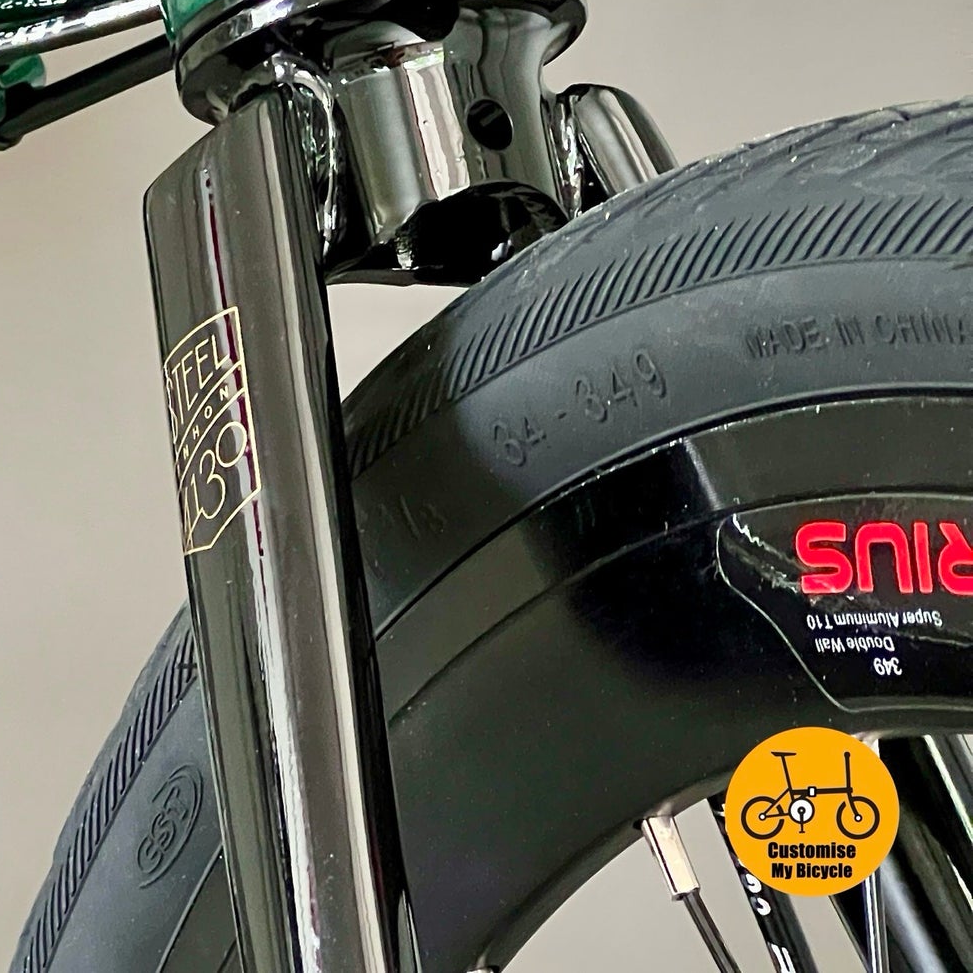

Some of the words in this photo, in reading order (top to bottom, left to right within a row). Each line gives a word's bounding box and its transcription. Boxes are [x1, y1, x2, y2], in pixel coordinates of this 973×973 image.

[745, 315, 824, 359] MADE
[831, 312, 866, 347] IN
[166, 334, 231, 444] STEEL
[176, 384, 229, 477] NHON
[806, 613, 834, 630] T10
[833, 611, 900, 628] Aluminum
[903, 610, 942, 627] Super
[815, 636, 846, 653] Wall
[847, 635, 895, 652] Double
[873, 657, 903, 676] 349
